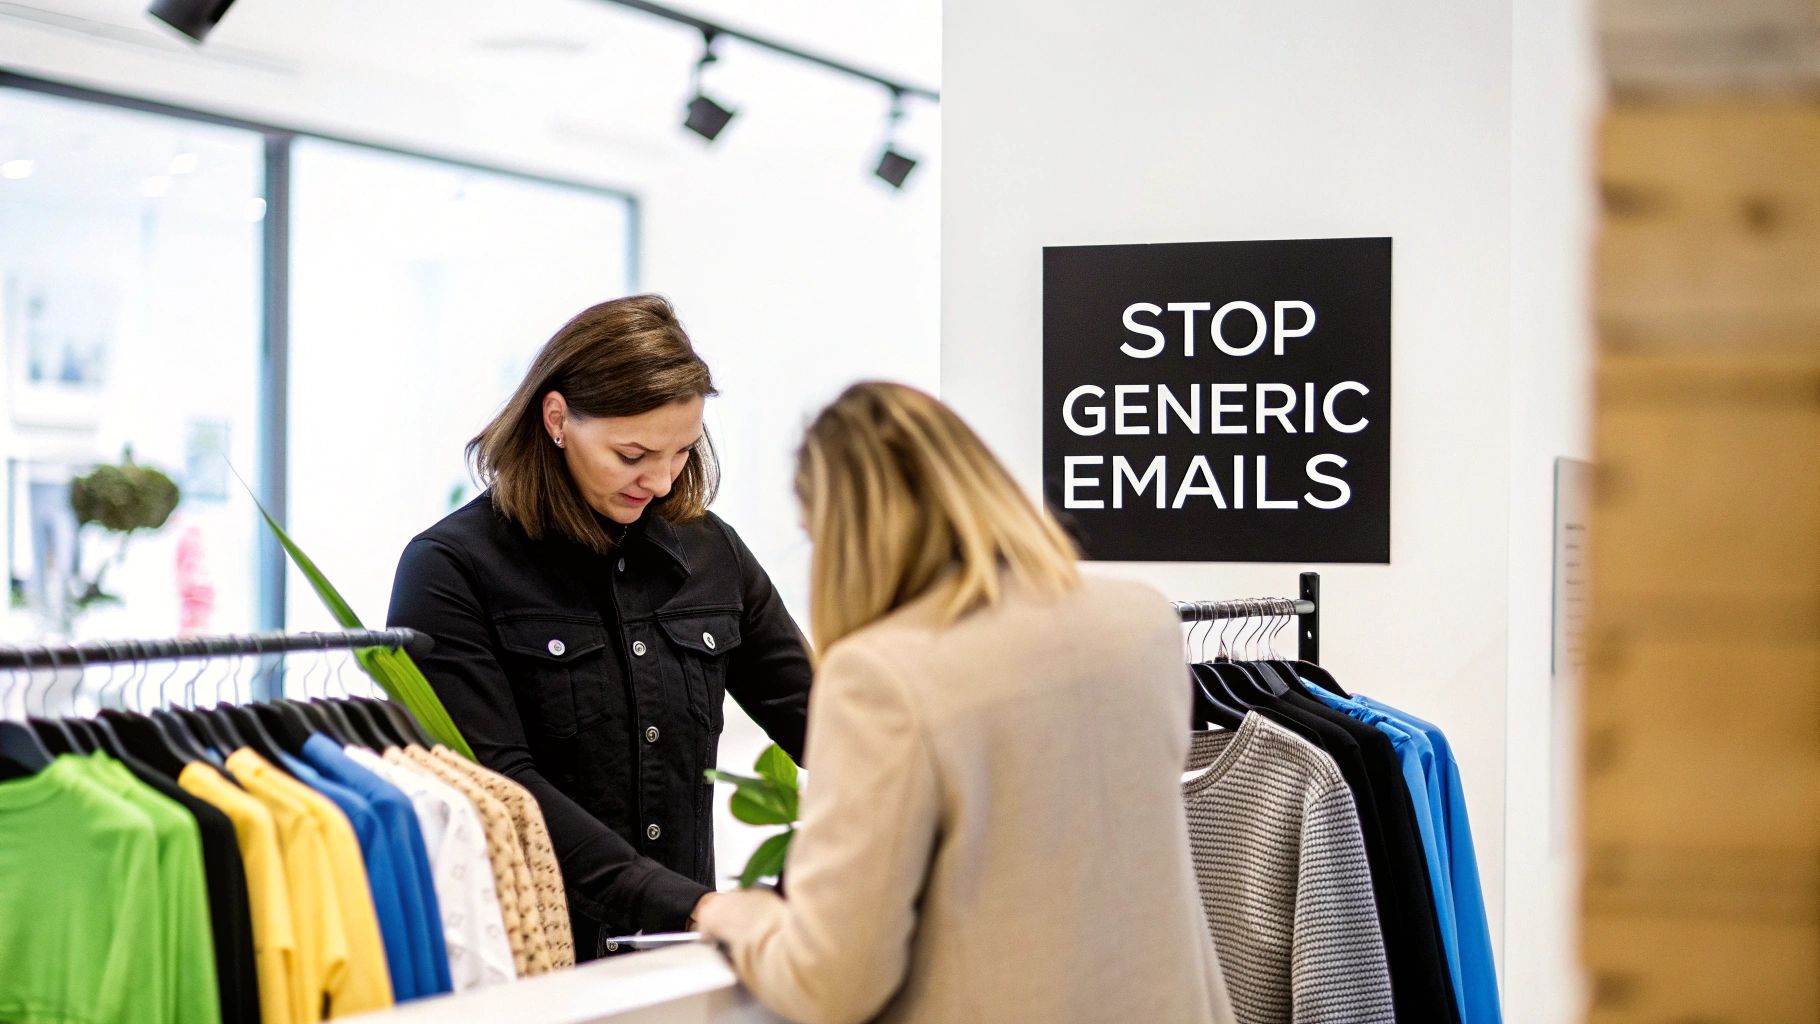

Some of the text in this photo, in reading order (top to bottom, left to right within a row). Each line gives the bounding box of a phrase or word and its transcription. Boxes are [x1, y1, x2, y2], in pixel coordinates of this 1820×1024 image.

[1119, 300, 1316, 359] STOP
[1062, 380, 1370, 436] GENERIC
[1064, 453, 1351, 510] EMAILS
